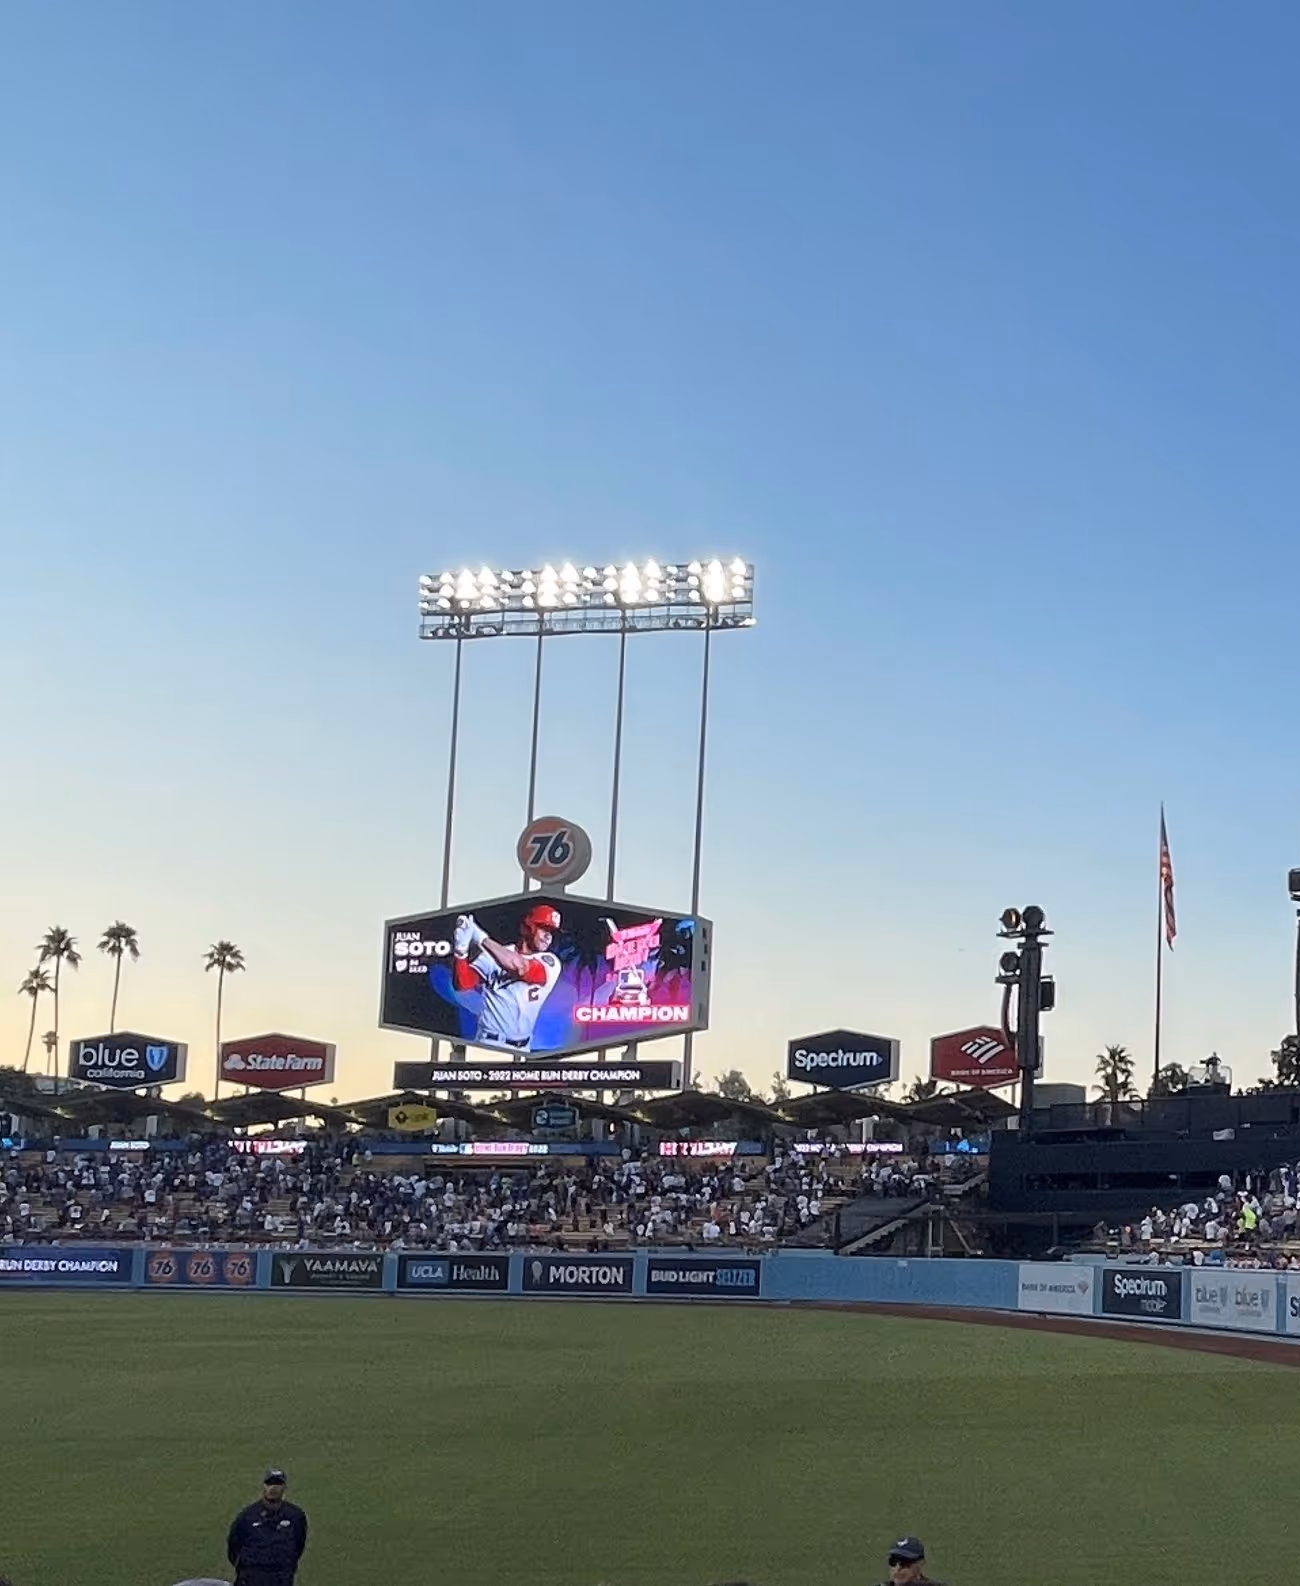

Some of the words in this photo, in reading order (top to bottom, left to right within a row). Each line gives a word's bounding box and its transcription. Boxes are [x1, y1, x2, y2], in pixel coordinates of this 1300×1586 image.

[526, 828, 574, 867] 76
[395, 932, 420, 941] JUAN
[394, 941, 451, 956] SOTO
[575, 1006, 689, 1021] CHAMPION
[79, 1041, 139, 1067] blue
[794, 1049, 877, 1071] Spectrum
[432, 1070, 456, 1081] JUAN
[458, 1070, 482, 1081] SOTO
[488, 1070, 511, 1081] 2022
[512, 1070, 540, 1081] HOME
[541, 1070, 560, 1081] RUN
[562, 1070, 589, 1081] DERBY
[590, 1070, 640, 1081] CHAMPION
[24, 1260, 57, 1271] DERBY
[58, 1260, 118, 1272] CHAMPION
[151, 1257, 176, 1277] 76
[189, 1257, 214, 1277] 76
[227, 1257, 250, 1277] 76
[412, 1265, 443, 1278] UCLA
[452, 1264, 499, 1281] Health
[549, 1265, 624, 1284] MORTON
[651, 1270, 678, 1282] BUD
[678, 1270, 715, 1283] LIGHT
[1114, 1274, 1166, 1298] Spectrum
[1234, 1286, 1259, 1307] blue
